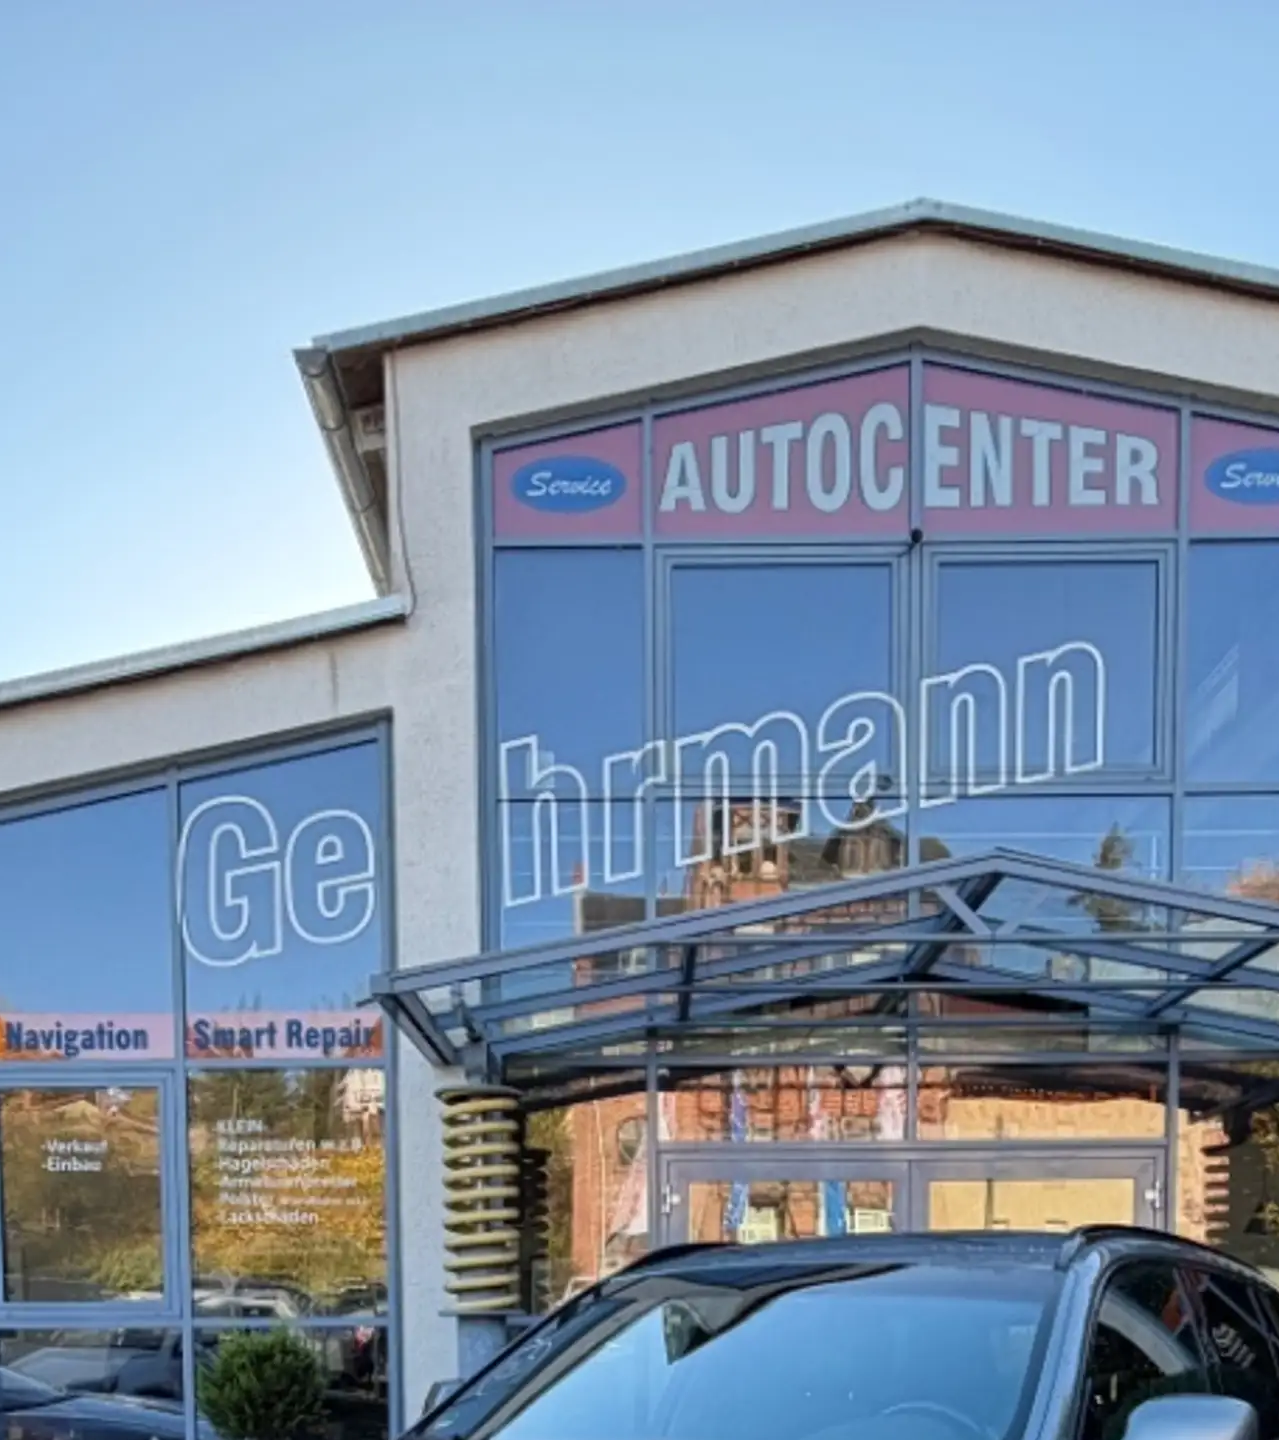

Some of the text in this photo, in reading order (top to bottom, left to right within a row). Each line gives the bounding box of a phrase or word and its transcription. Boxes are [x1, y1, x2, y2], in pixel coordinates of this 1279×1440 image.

[659, 402, 1160, 517] AUTOCENTER
[526, 472, 613, 497] Service
[5, 1021, 149, 1058] Navigation
[193, 1018, 376, 1055] Smart Repair
